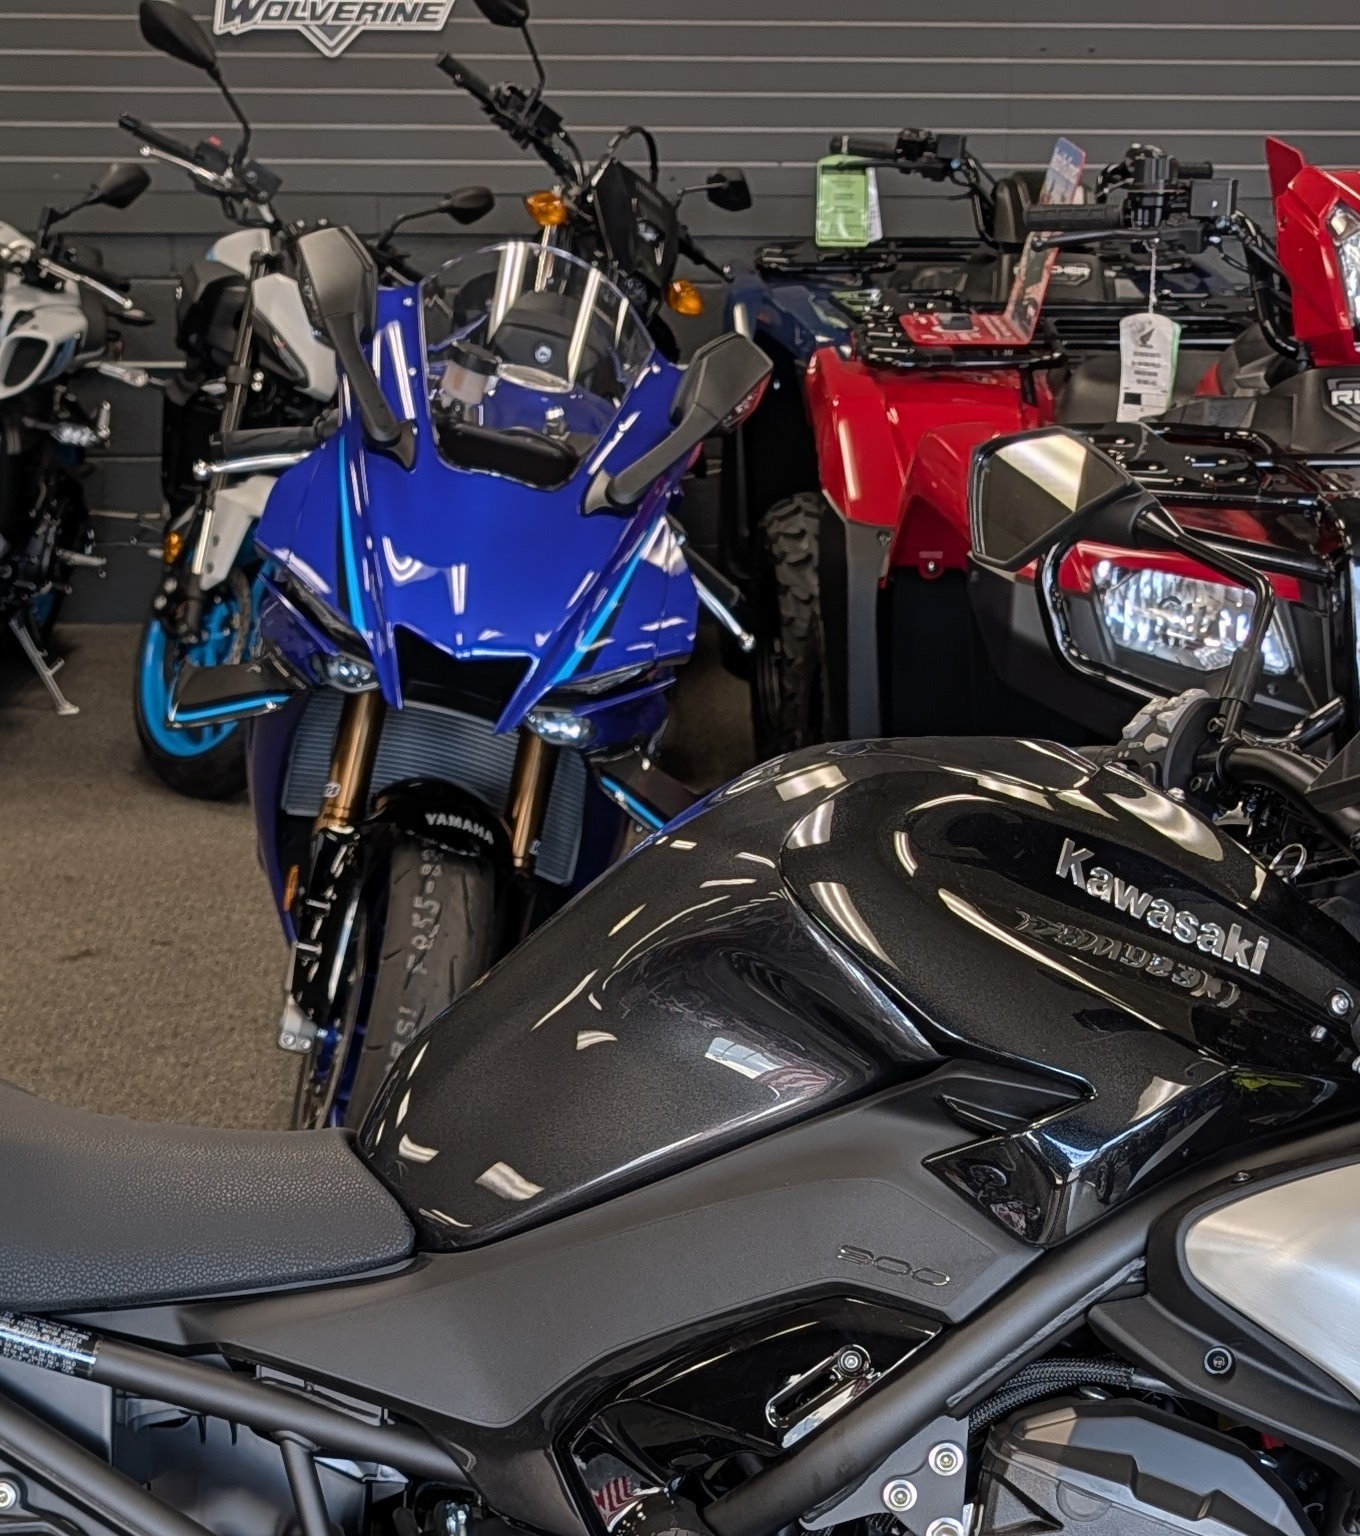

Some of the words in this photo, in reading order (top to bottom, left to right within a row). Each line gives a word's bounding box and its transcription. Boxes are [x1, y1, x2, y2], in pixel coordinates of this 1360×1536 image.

[222, 1, 443, 24] WOLVERINE
[424, 811, 495, 846] YAMAHA
[1054, 837, 1271, 976] Kawasaki
